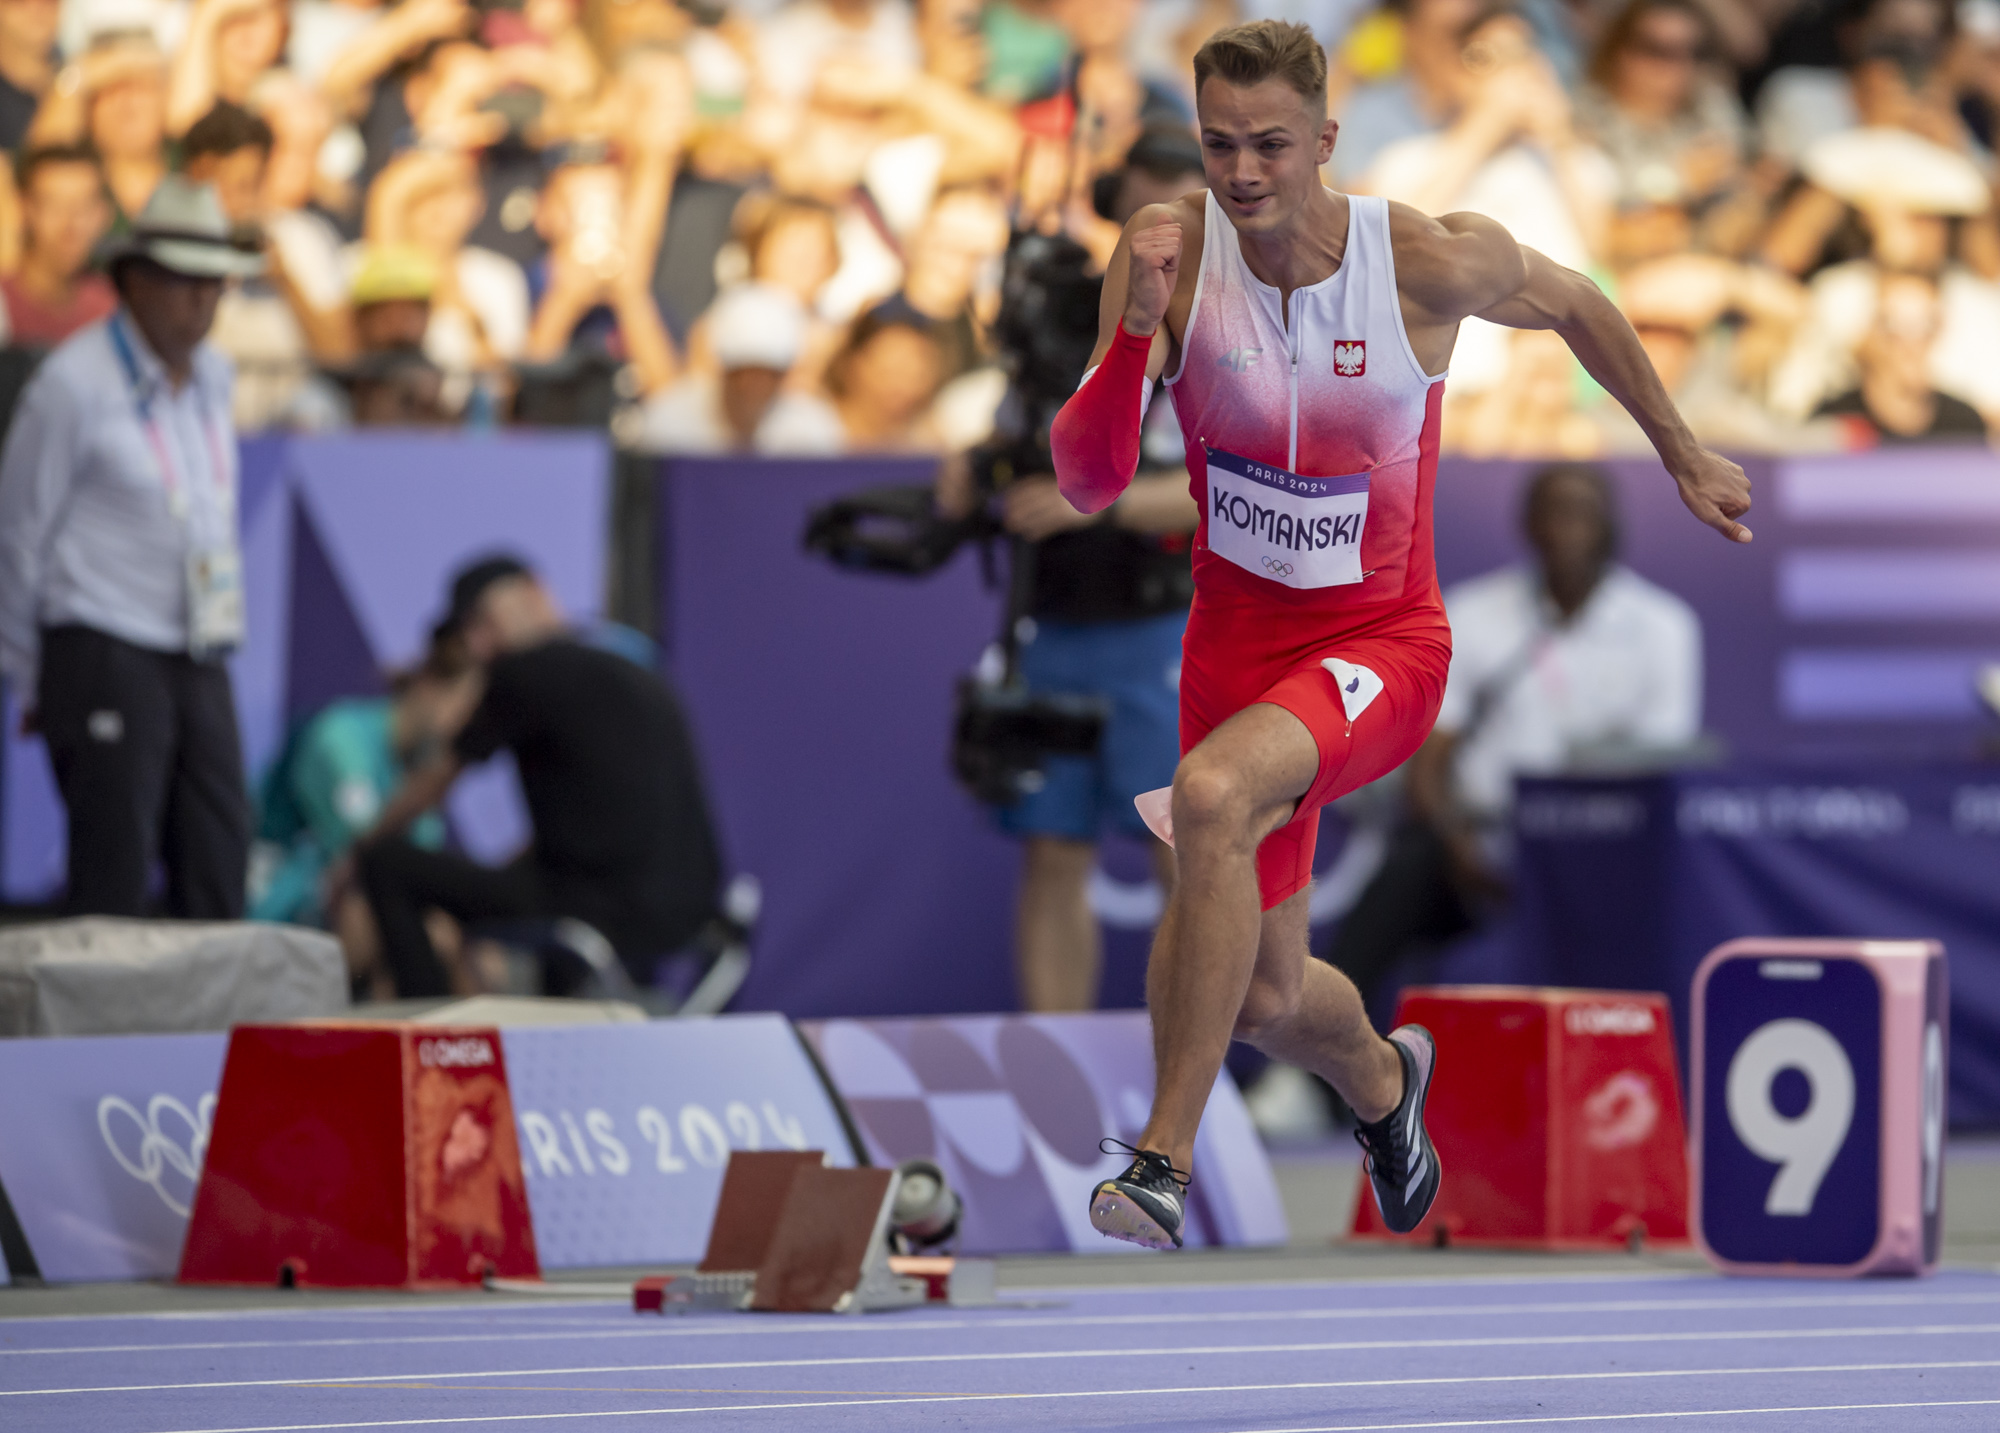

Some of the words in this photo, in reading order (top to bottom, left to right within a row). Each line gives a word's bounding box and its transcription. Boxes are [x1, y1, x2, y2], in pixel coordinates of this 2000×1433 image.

[1216, 346, 1264, 373] 4F
[1246, 464, 1286, 486] PARIS
[1289, 478, 1328, 493] 2024
[1213, 486, 1362, 552] KOMANSKI
[519, 1107, 632, 1177] RIS
[1725, 1016, 1857, 1217] 9
